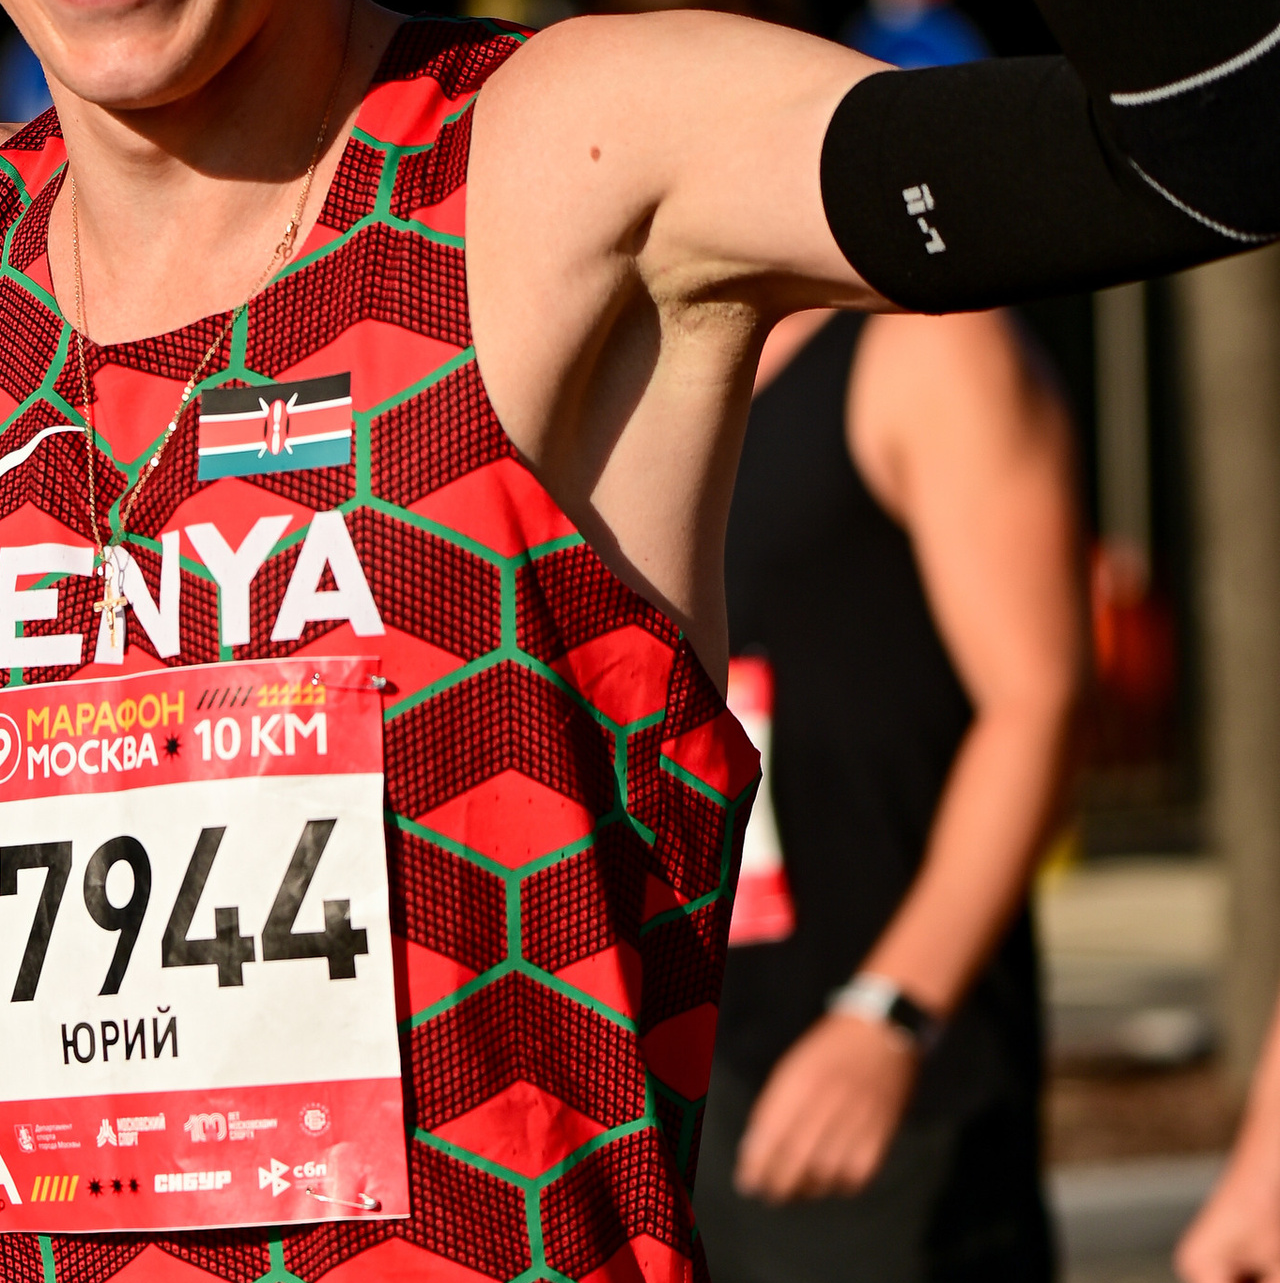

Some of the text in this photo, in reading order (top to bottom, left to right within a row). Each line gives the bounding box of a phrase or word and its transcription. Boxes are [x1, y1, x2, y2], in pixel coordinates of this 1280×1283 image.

[26, 689, 185, 743] МАРАФОН
[193, 711, 328, 762] 10 КМ
[26, 732, 160, 781] МОСКВА
[60, 1004, 179, 1065] ЮРИЙ
[154, 1169, 232, 1193] СИБУР
[292, 1160, 327, 1178] сбп
